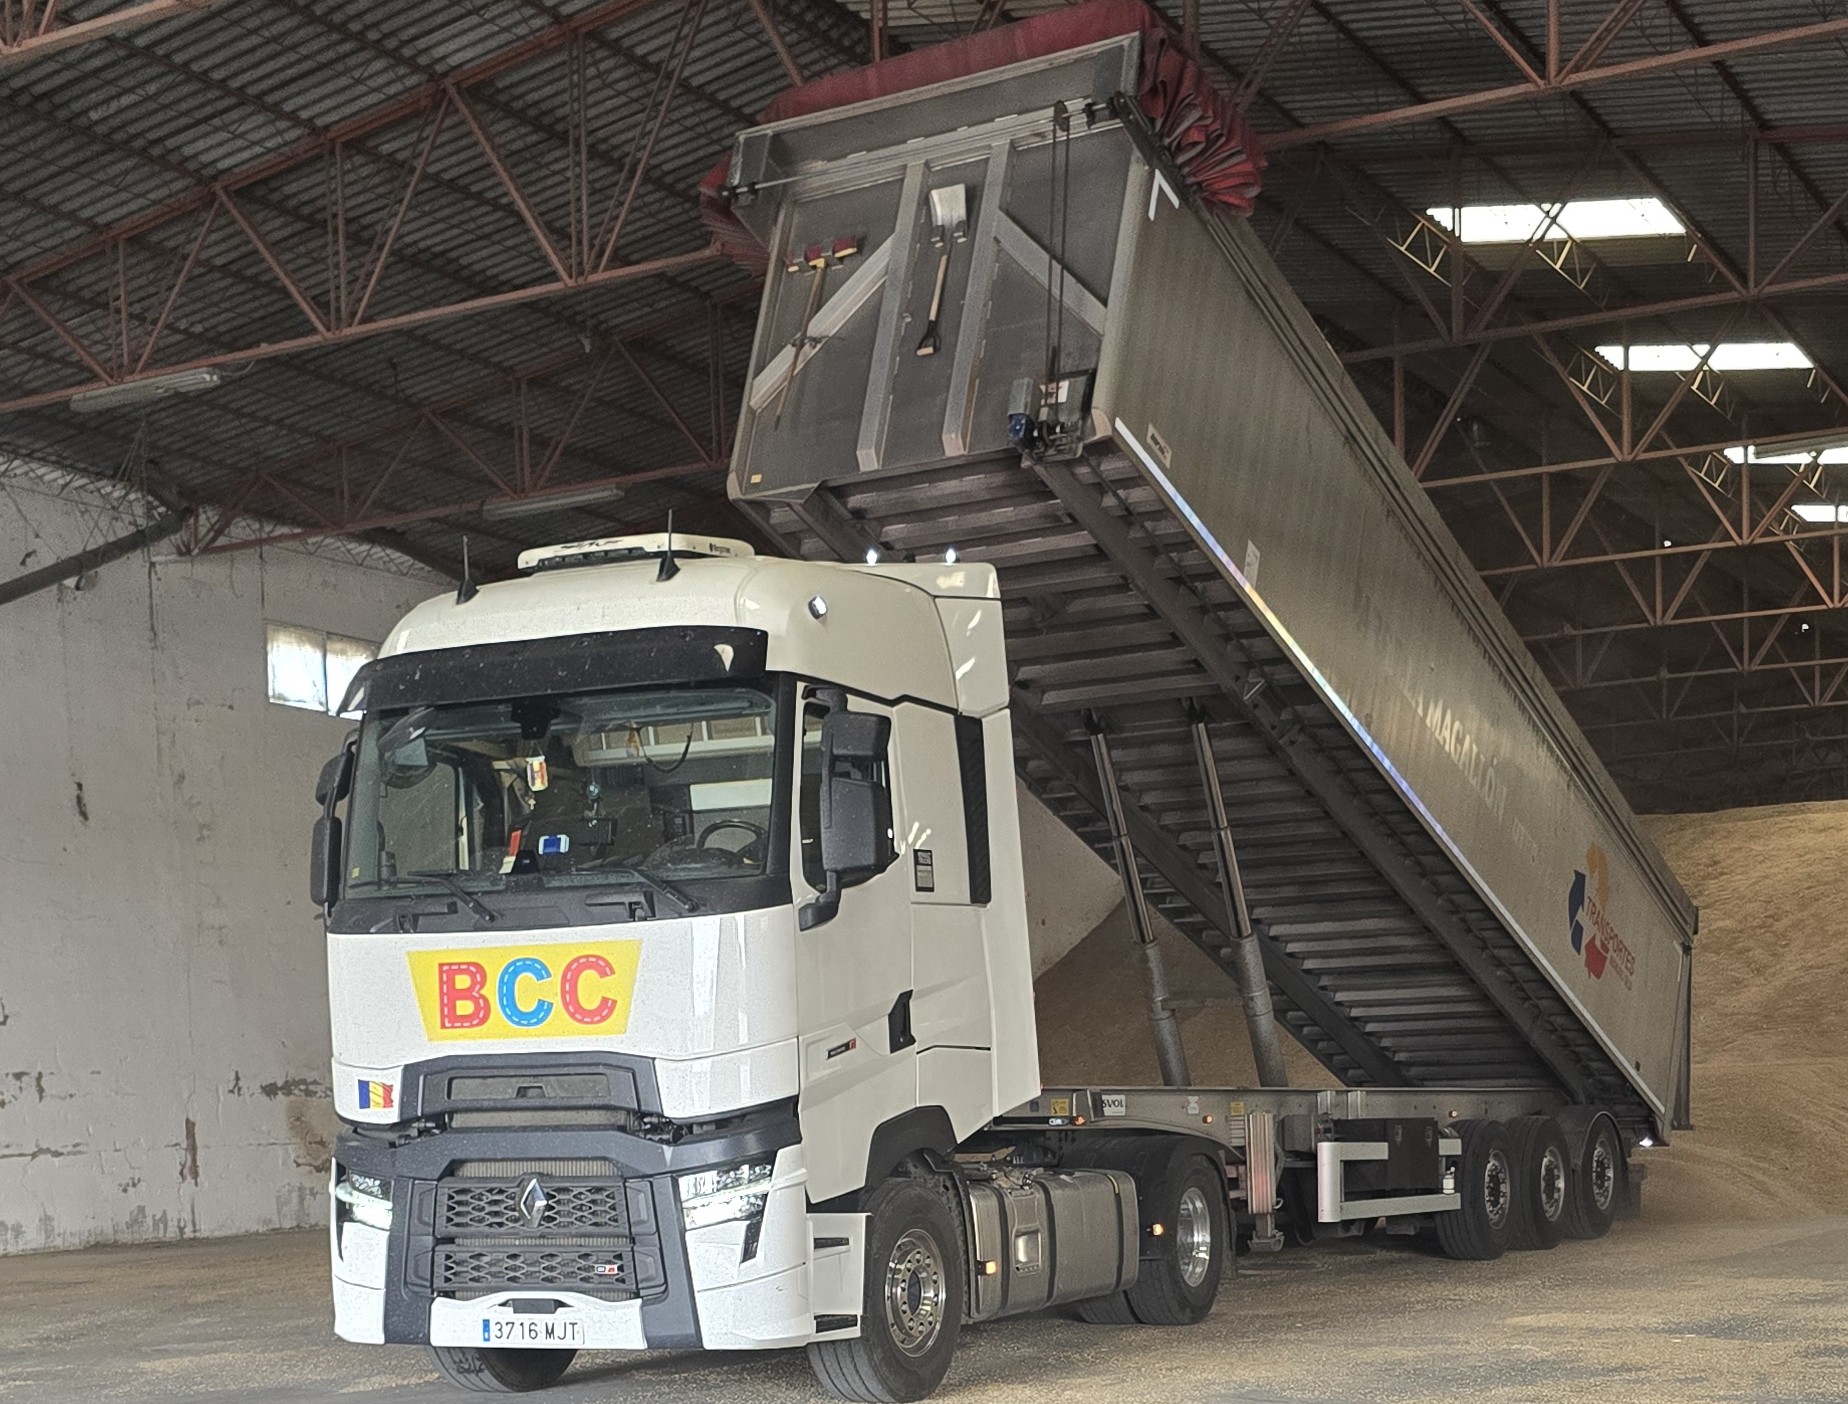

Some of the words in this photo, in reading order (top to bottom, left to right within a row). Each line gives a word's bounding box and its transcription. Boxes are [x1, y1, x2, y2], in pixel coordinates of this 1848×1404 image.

[437, 954, 618, 1030] BCC
[1101, 1098, 1124, 1108] SVOL
[494, 1321, 539, 1340] 3716
[545, 1321, 579, 1341] MJT
